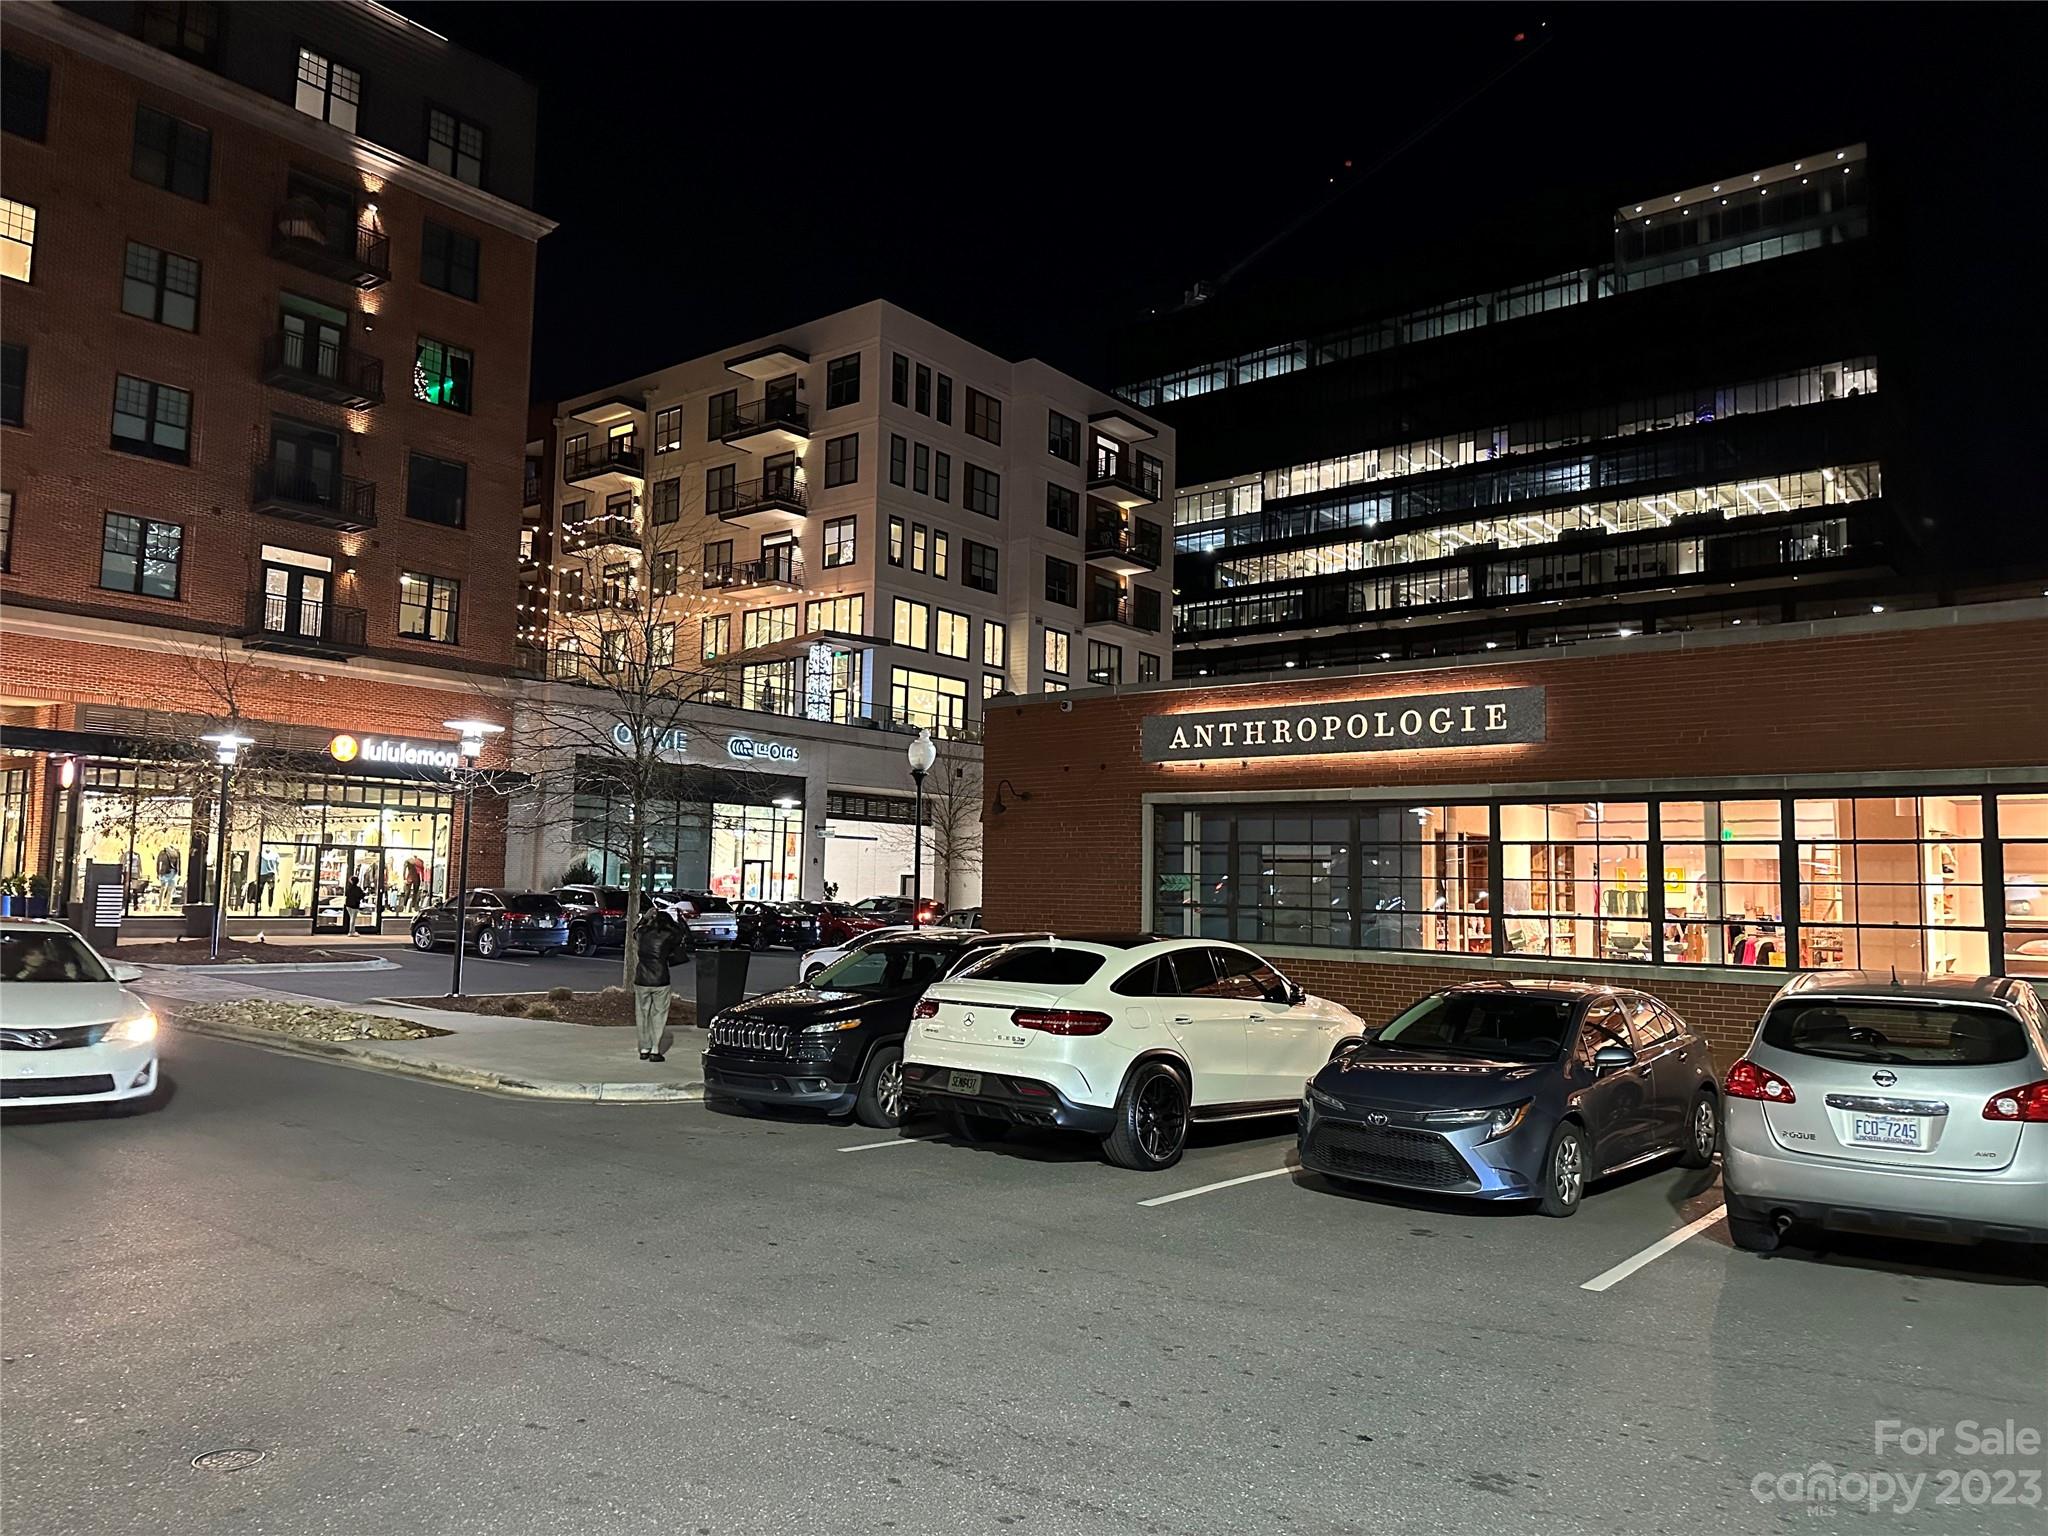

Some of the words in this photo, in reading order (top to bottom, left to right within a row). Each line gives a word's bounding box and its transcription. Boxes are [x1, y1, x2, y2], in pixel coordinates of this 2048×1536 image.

[1168, 703, 1508, 750] ANTHROPOLOGIE
[362, 738, 459, 769] lululemon
[1782, 1130, 1816, 1141] ROGUE
[1855, 1119, 1917, 1139] FCD-7245
